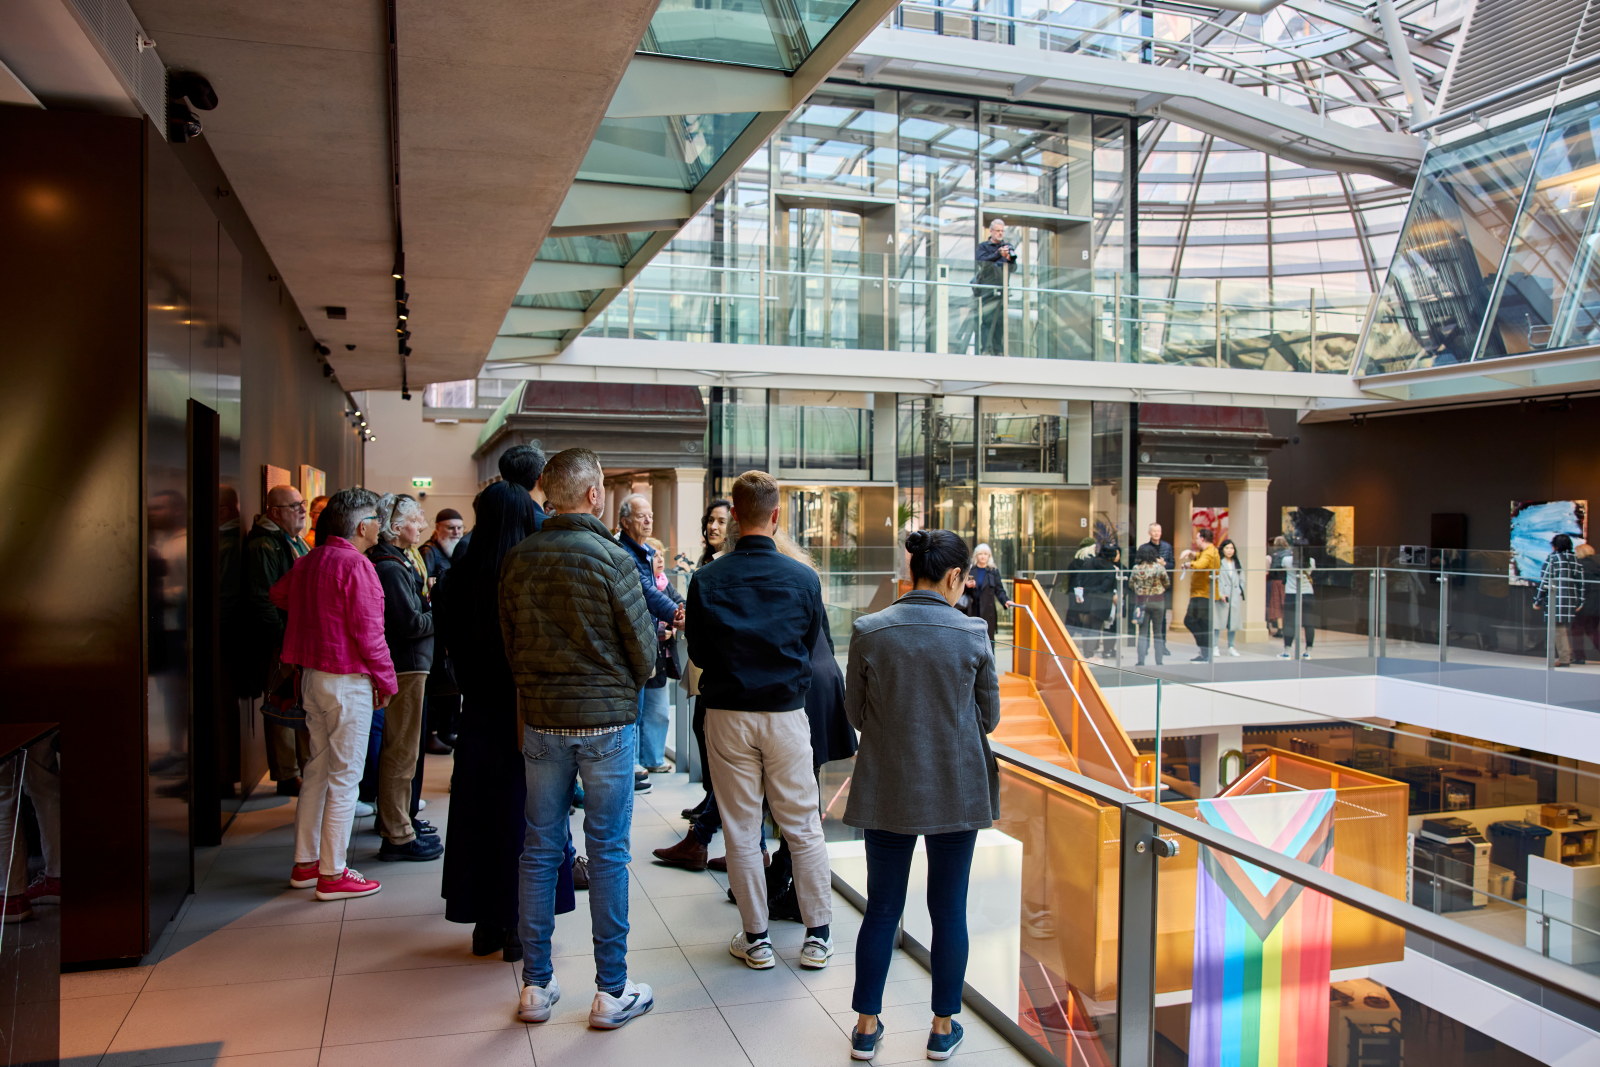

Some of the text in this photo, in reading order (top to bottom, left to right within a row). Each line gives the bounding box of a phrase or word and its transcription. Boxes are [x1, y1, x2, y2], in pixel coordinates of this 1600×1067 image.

[886, 234, 894, 245] A
[1082, 250, 1089, 260] B
[885, 516, 892, 527] A
[1081, 518, 1088, 528] B
